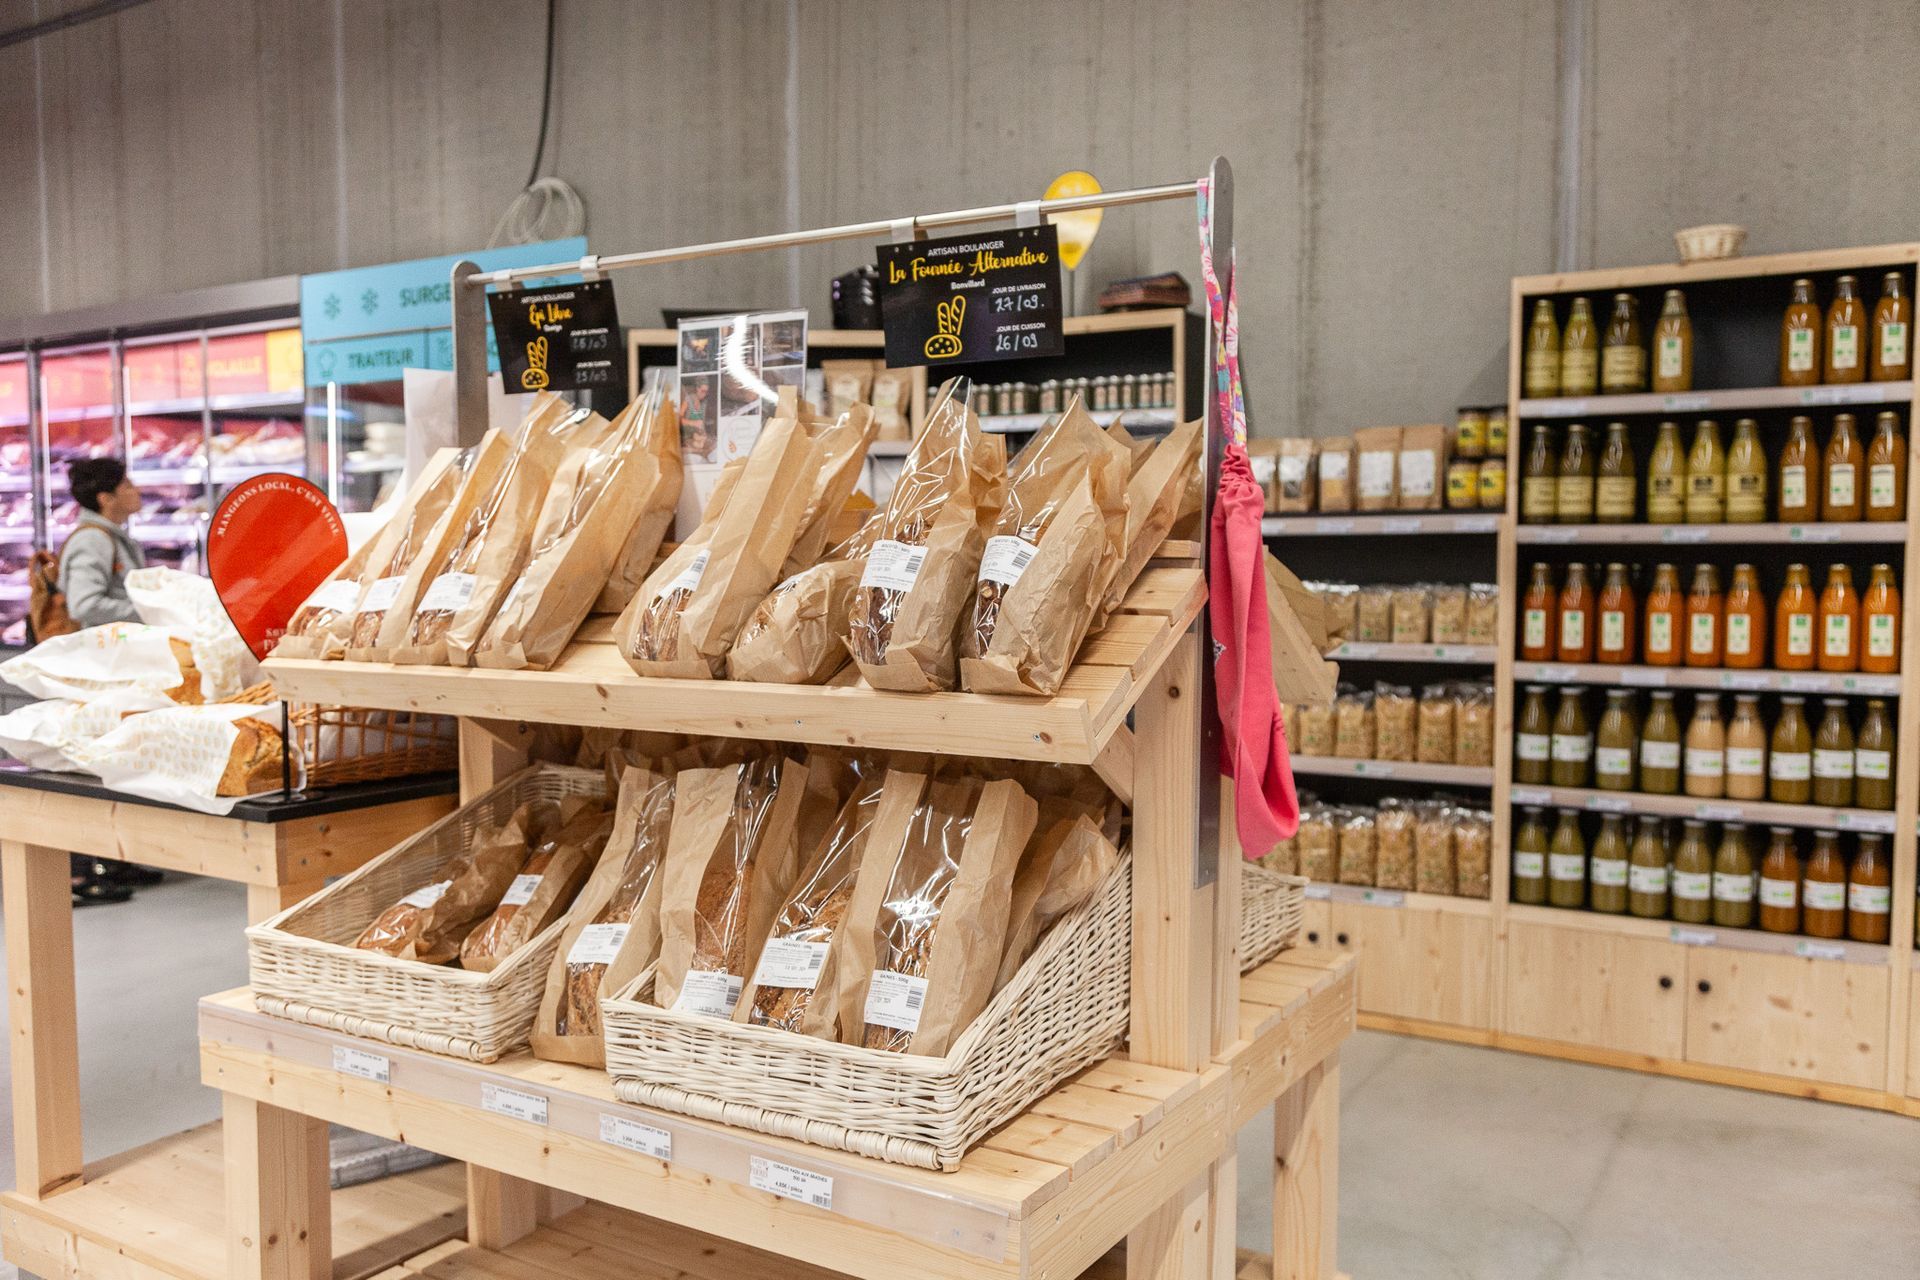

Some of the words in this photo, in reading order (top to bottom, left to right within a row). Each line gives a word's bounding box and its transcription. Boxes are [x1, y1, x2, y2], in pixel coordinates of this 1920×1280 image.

[928, 246, 959, 257] ARTISAN
[959, 240, 1005, 254] BOULANGER
[889, 260, 907, 284] La
[911, 256, 964, 282] Fournée
[968, 246, 1049, 277] Alternative
[951, 278, 986, 291] Bonvillard
[992, 286, 1007, 295] JOUR
[1007, 285, 1016, 293] DE
[1016, 282, 1046, 292] LIVRAISON
[996, 325, 1011, 333] JOUR
[1020, 322, 1046, 331] CUISSON
[348, 347, 414, 369] TRAITEUR
[217, 486, 258, 538] MANGEONS
[296, 485, 323, 507] C'EST
[321, 505, 340, 536] VITAL
